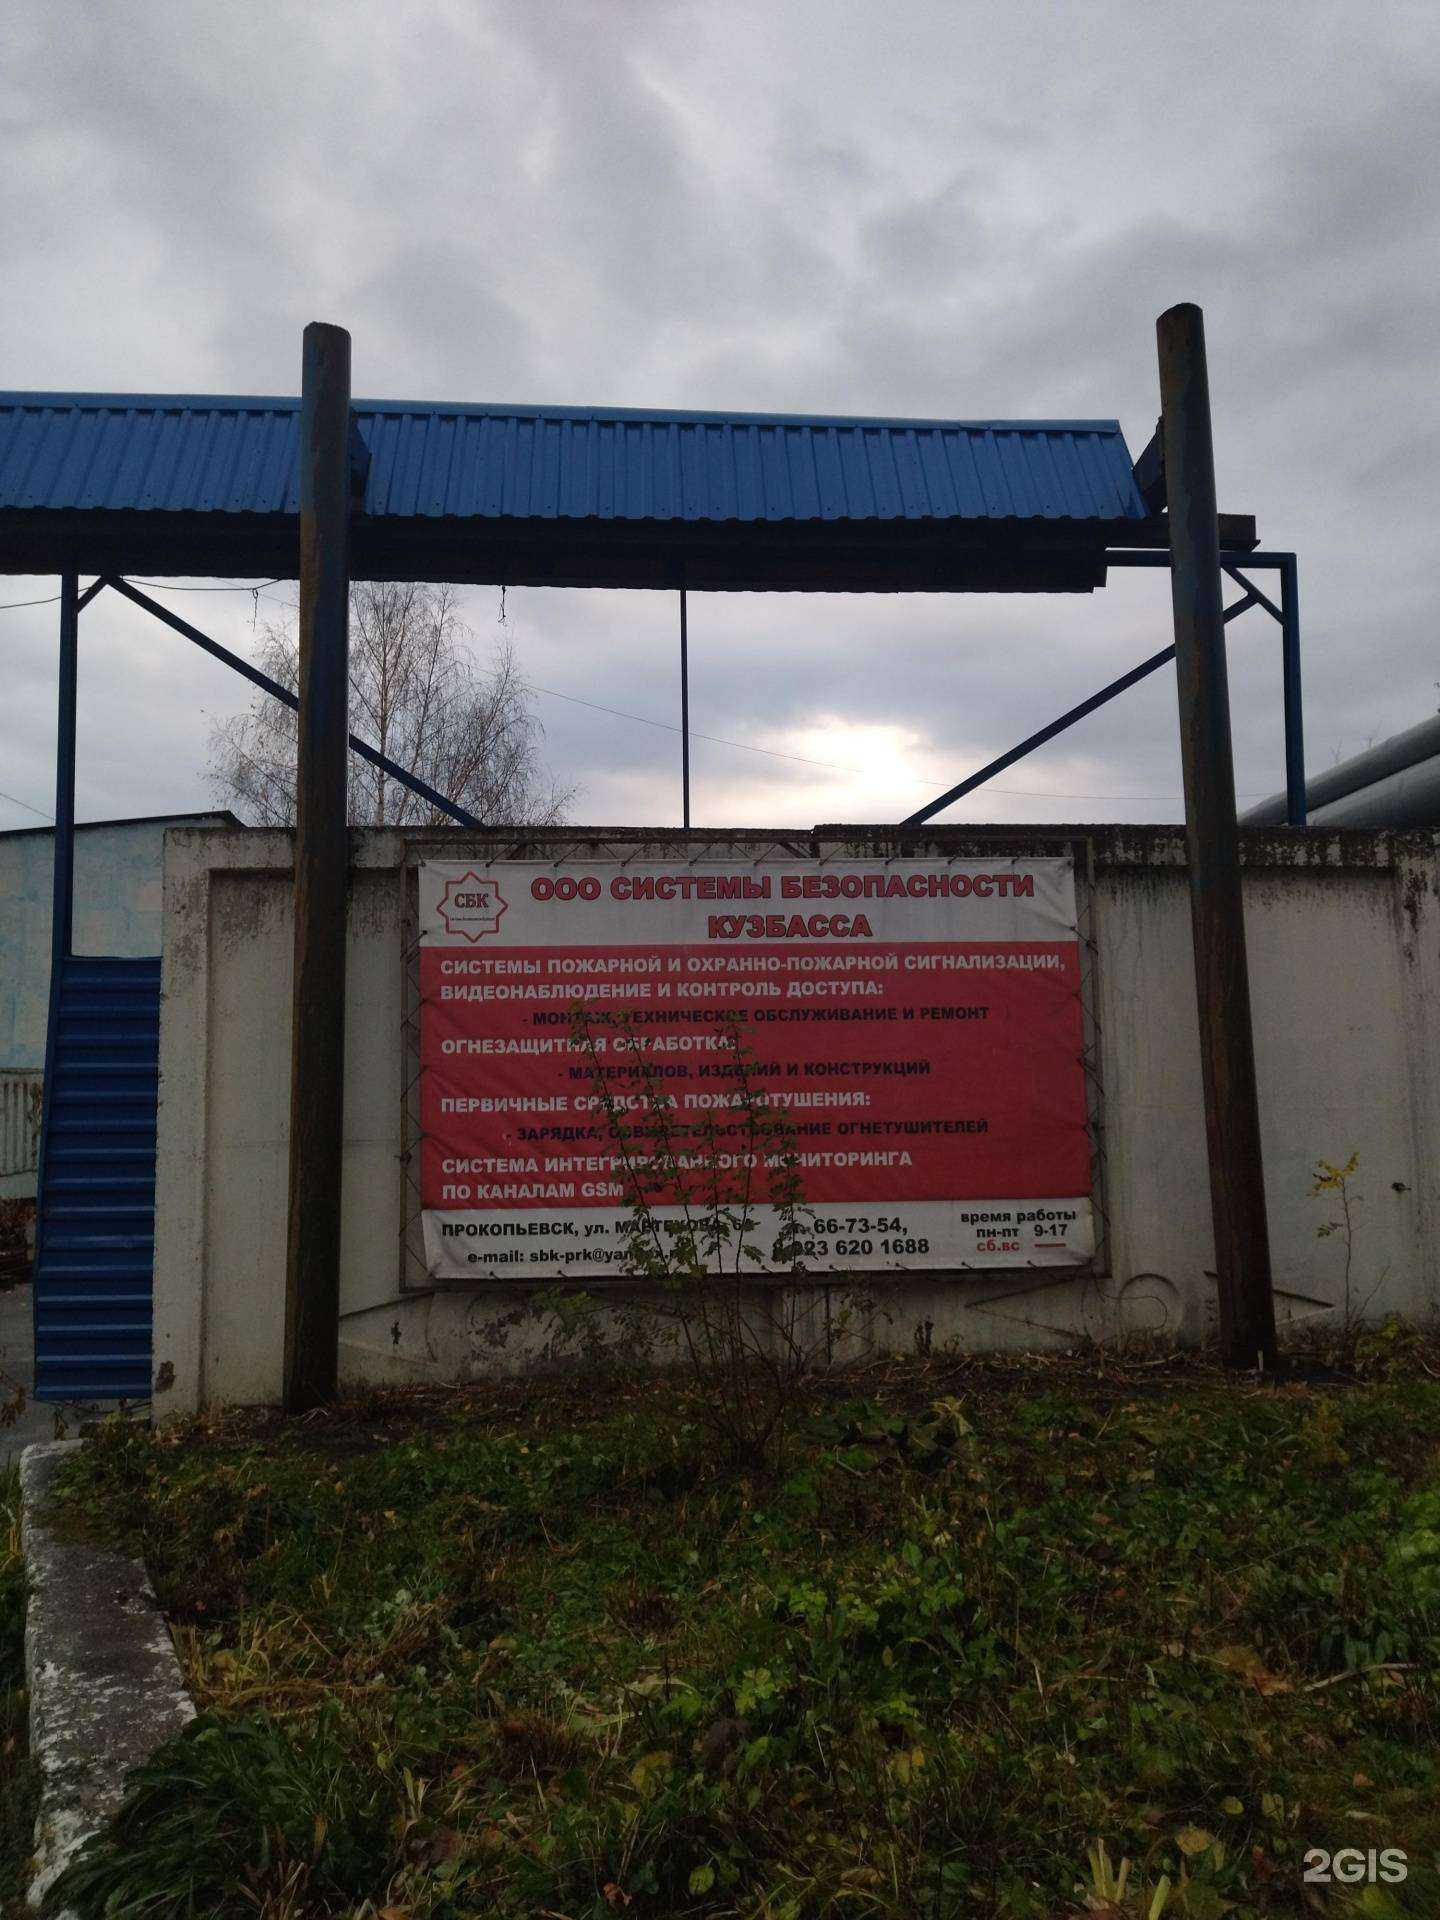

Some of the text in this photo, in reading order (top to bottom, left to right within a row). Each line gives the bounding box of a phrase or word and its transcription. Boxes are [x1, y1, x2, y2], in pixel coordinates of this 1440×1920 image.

[531, 873, 1035, 901] ООО СИСТЕМЫ БЕЗОПАСНОСТИ
[454, 893, 489, 909] СБК
[708, 913, 873, 939] КУЗБАССА
[440, 952, 1066, 975] СИСТЕМЫ ПОЖАРНОЙ И ОХРАННО-ПОЖАРНОЙ СИГНАЛИЗАЦИИ,
[440, 980, 884, 1002] ВИДЕОНАБЛЮДЕНИЕ И КОНТРОЛЬ ДОСТУПА:
[754, 1006, 898, 1022] ОБСЛУЖИВАНИЕ
[903, 1006, 914, 1020] И
[919, 1005, 990, 1020] РЕМОНТ
[440, 1037, 608, 1056] ОГНЕЗАЩИТНАЯ
[568, 1064, 693, 1081] МАТЕРИАЛОВ,
[786, 1062, 799, 1075] И
[804, 1060, 930, 1077] КОНСТРУКЦИЙ
[440, 1097, 567, 1113] ПЕРВИЧНЫЕ
[517, 1127, 603, 1145] ЗАРЯДКА,
[838, 1118, 988, 1135] ОГНЕТУШИТЕЛЕЙ
[441, 1158, 538, 1174] СИСТЕМА
[442, 1185, 471, 1200] ПО
[477, 1183, 575, 1199] КАНАЛАМ
[960, 1208, 1077, 1224] время работы
[441, 1221, 579, 1237] ПРОКОПЬЕВСК,
[584, 1223, 609, 1239] ул.
[813, 1217, 908, 1235] 66-73-54,
[976, 1223, 1068, 1238] пн-пт 9-17
[835, 1240, 872, 1255] 620
[880, 1238, 929, 1254] 1688
[976, 1239, 1020, 1251] сб.вс
[467, 1250, 524, 1264] e-mail:
